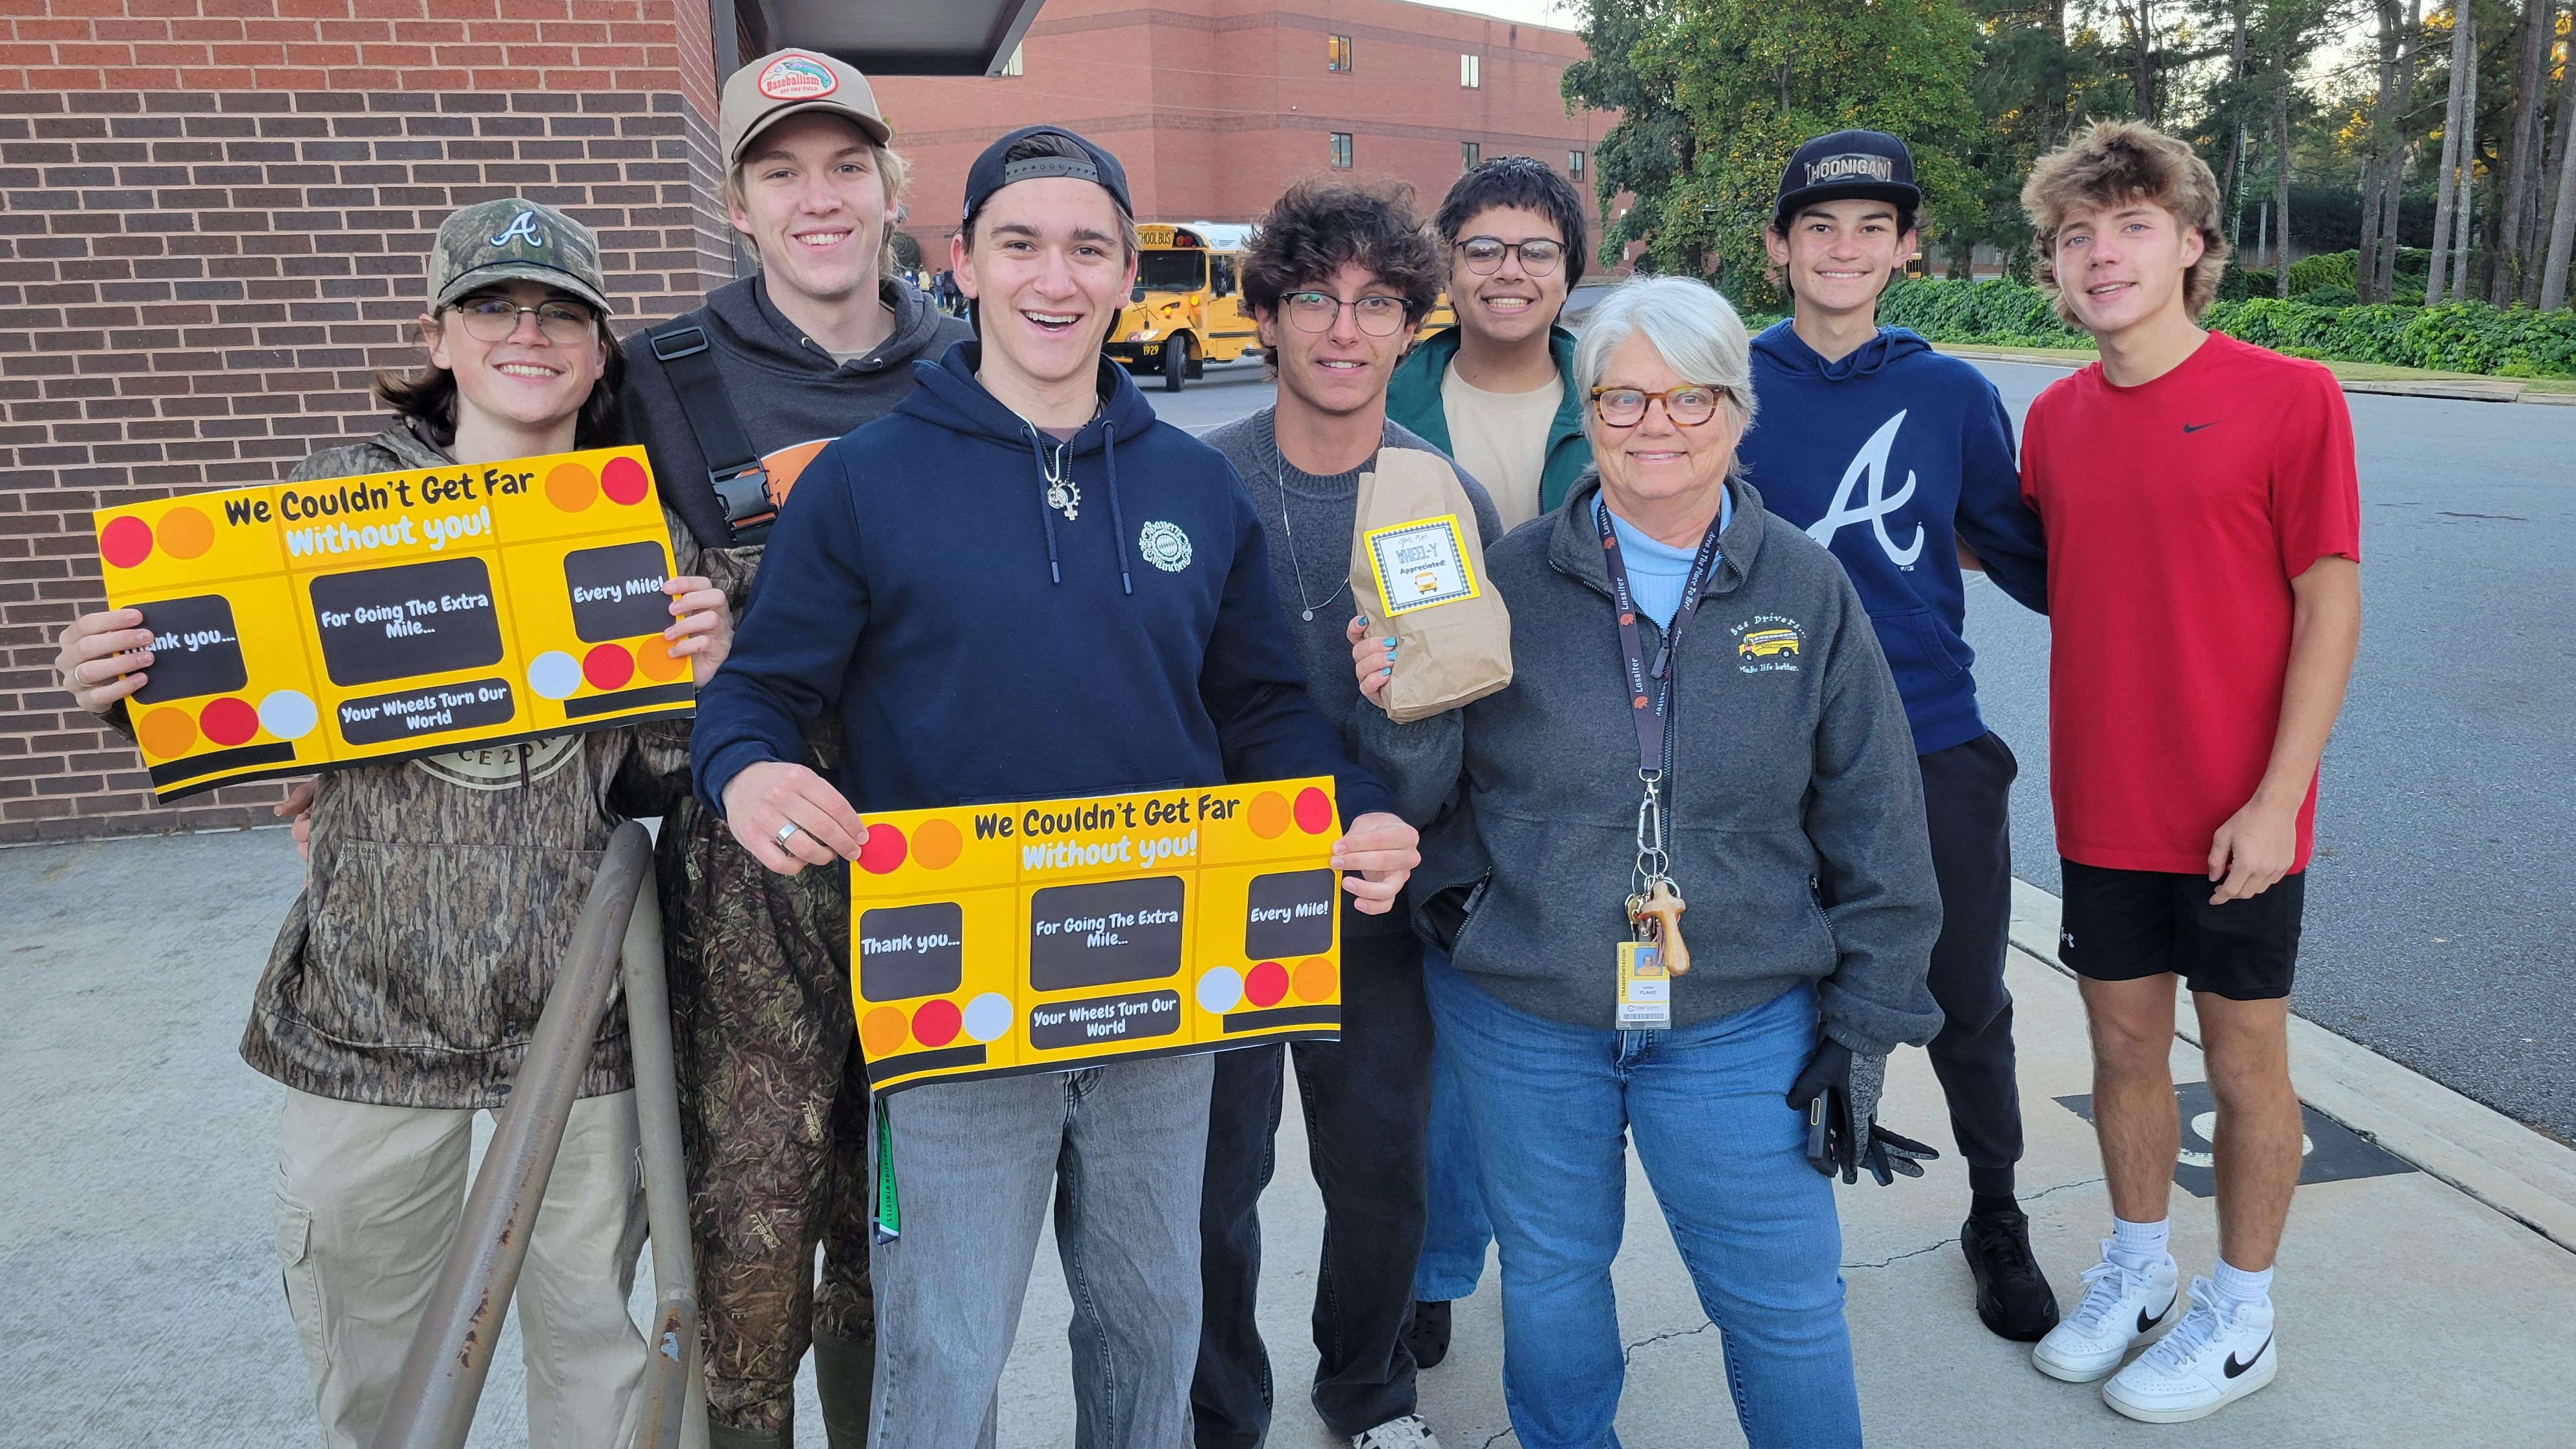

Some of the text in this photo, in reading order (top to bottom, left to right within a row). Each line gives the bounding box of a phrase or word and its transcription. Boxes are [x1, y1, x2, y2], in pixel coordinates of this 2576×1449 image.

[767, 74, 820, 91] Baseballism
[1158, 232, 1171, 245] BUS
[1143, 345, 1160, 356] 1929
[225, 469, 535, 527] We Couldn't Get Far
[1600, 505, 1610, 535] Lassiter
[286, 505, 492, 558] Without you!
[1705, 531, 1716, 548] Area
[1395, 542, 1438, 564] WHEEL-Y
[1697, 554, 1708, 566] The
[1400, 559, 1446, 574] Appreciated!
[1690, 567, 1703, 586] Place
[574, 575, 664, 603] Every Mile!
[1618, 577, 1629, 610] Lassiter
[1687, 587, 1697, 596] To
[321, 593, 489, 628] For Going The Extra
[1683, 596, 1694, 611] Be!
[386, 621, 435, 639] Mile...
[1731, 620, 1749, 636] Bus
[184, 630, 236, 652] you...
[1631, 657, 1643, 693] Lassiter
[1760, 663, 1773, 672] life
[341, 687, 507, 724] Your Wheels Turn Our
[1655, 681, 1668, 716] Lassiter
[406, 709, 452, 731] World
[975, 794, 1240, 841] We Couldn't Get Far
[1023, 829, 1197, 871] Without you!
[1036, 909, 1178, 936] For Going The Extra
[1250, 900, 1328, 923] Every Mile!
[861, 934, 960, 955] Thank you...
[1087, 932, 1128, 948] Mile...
[1034, 998, 1176, 1027] Your Wheels Turn Our
[1087, 1019, 1126, 1038] World
